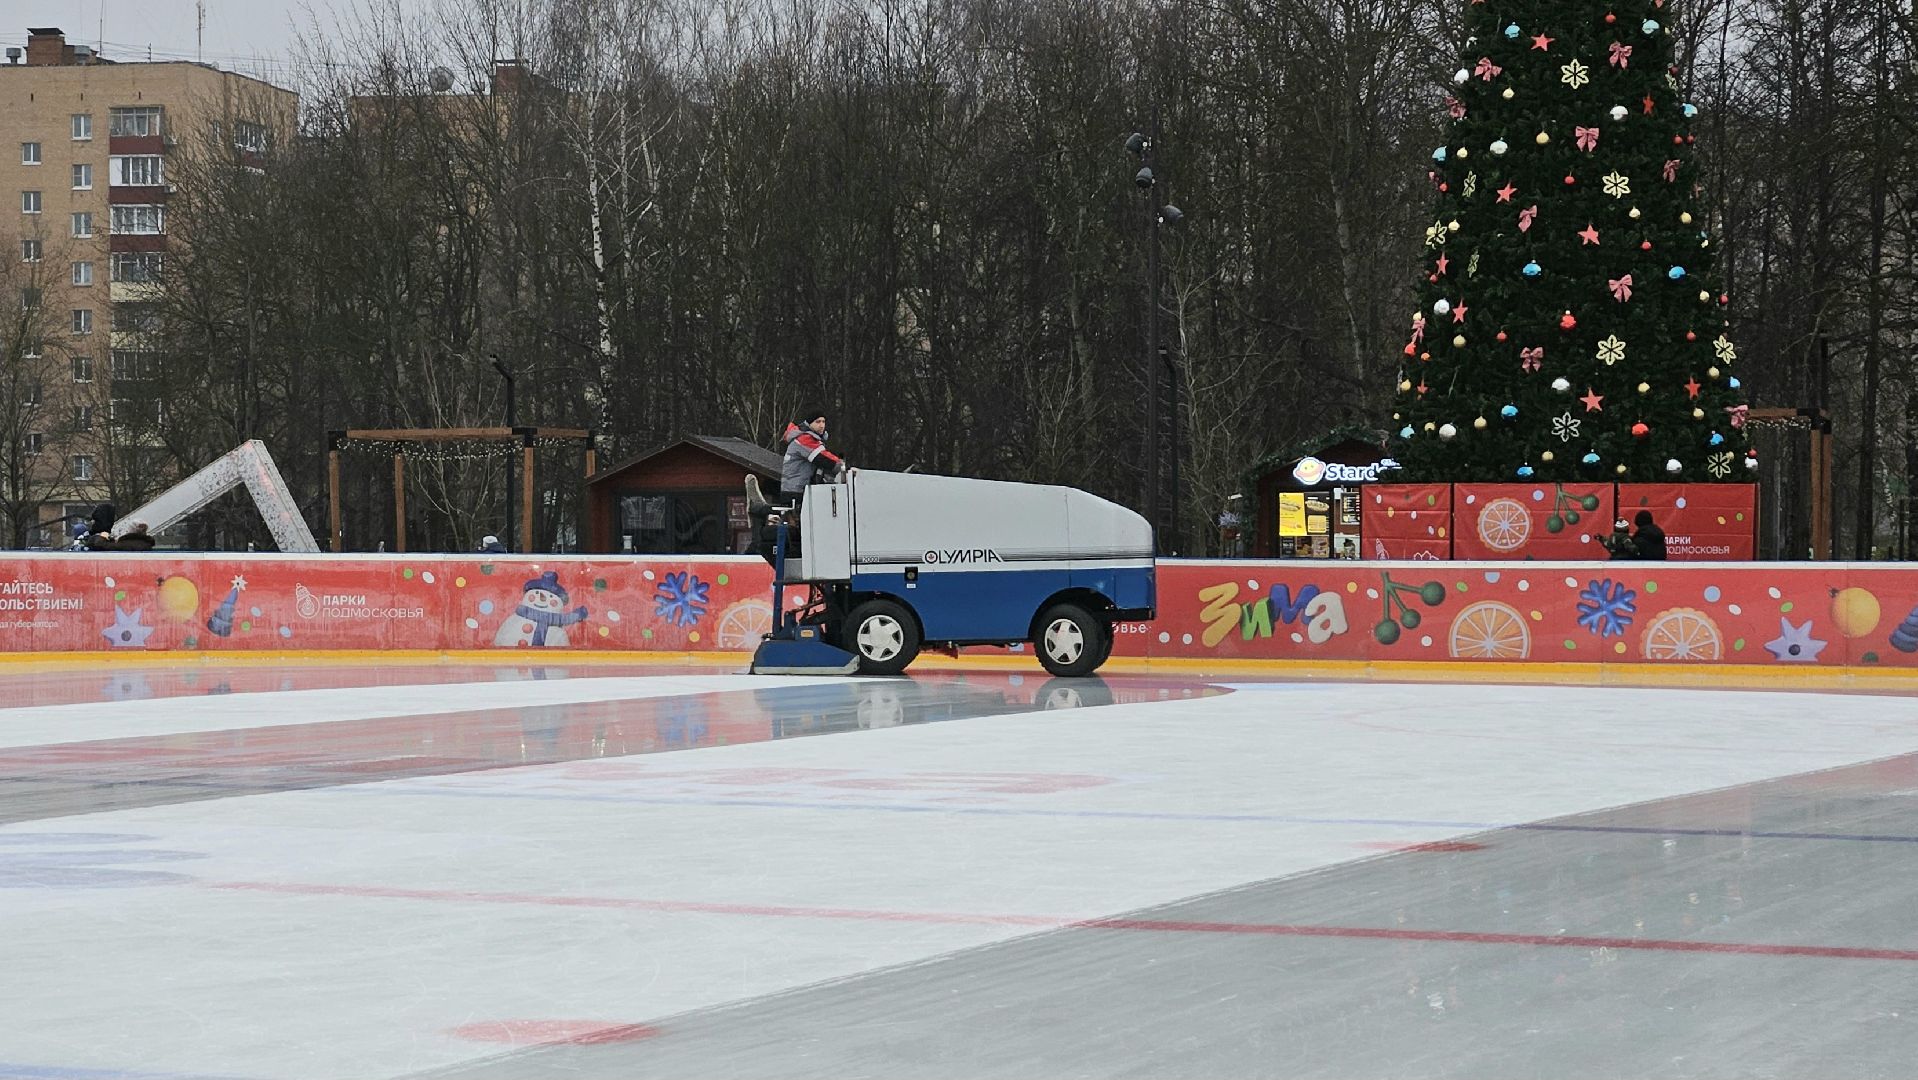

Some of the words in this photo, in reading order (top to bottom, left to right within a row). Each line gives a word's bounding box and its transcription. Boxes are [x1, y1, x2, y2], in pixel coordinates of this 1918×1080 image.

[925, 549, 1001, 564] OLYMPIA
[323, 595, 366, 606] ПАРКИ
[322, 607, 424, 618] ПОДМОСКОВЬЯ
